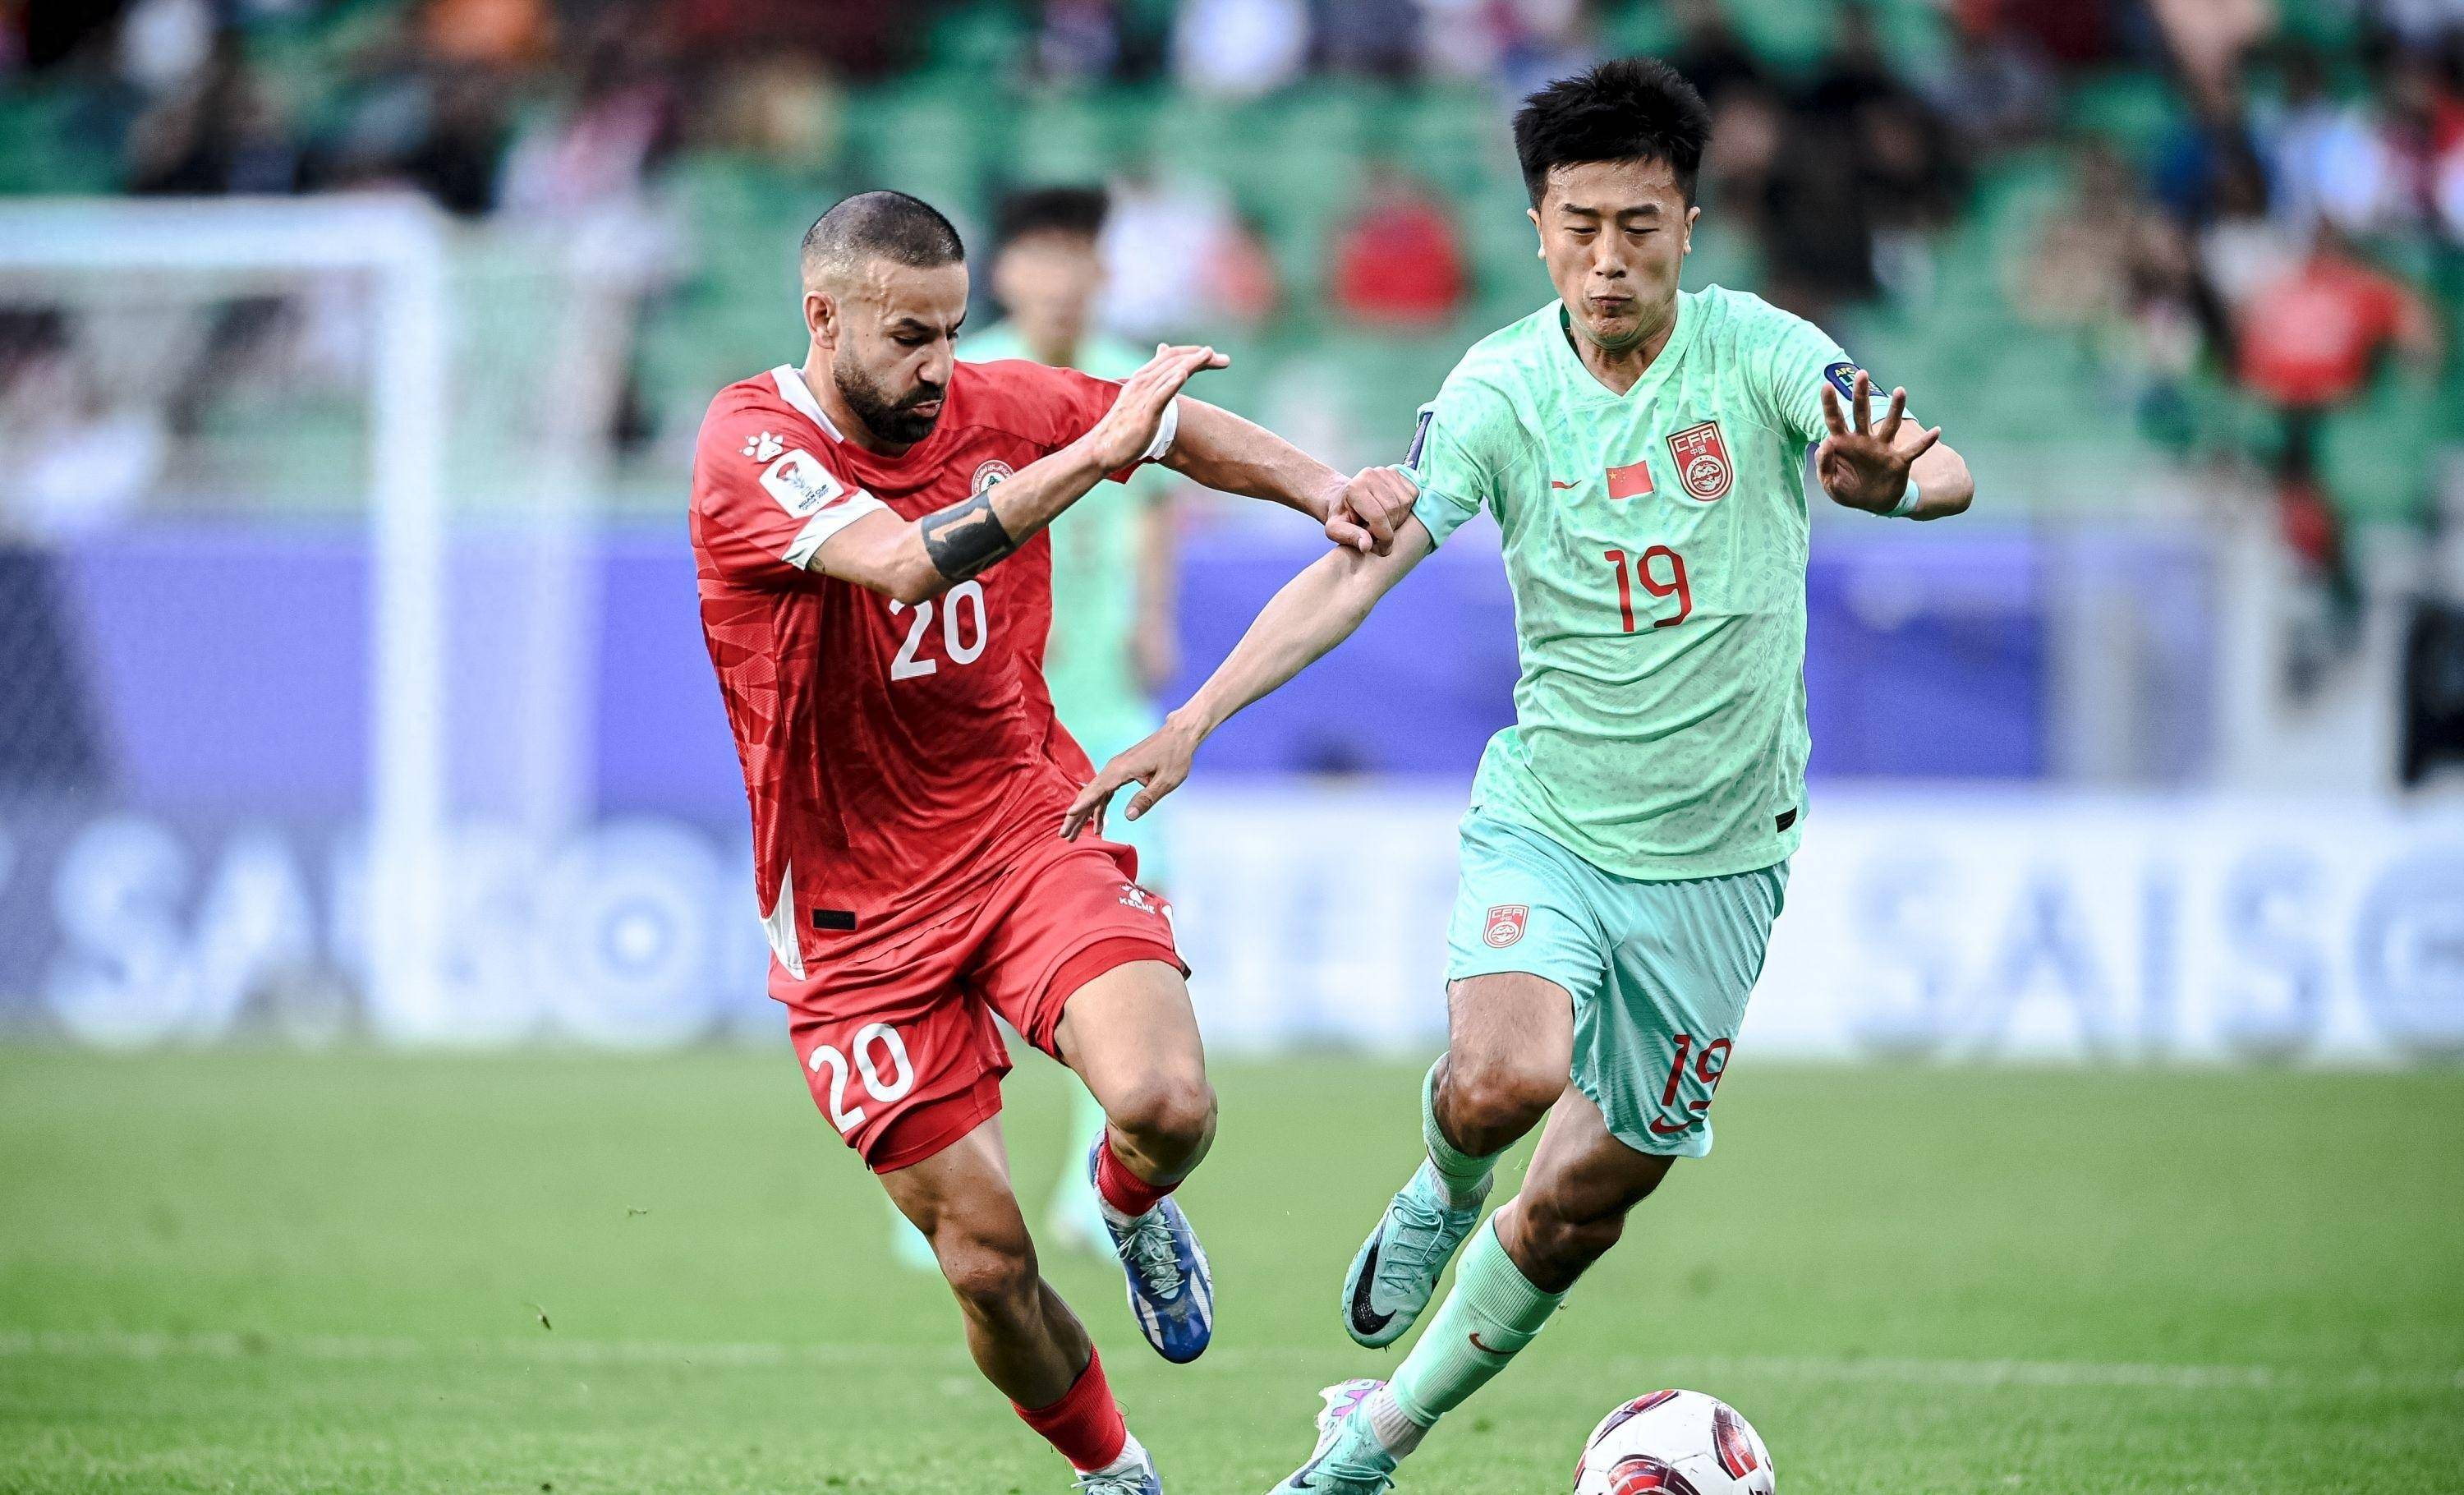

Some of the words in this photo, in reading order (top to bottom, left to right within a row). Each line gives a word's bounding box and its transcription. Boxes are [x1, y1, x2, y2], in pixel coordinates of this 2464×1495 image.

[1834, 367, 1855, 377] AFC
[1674, 428, 1716, 453] CFA
[1603, 545, 1693, 632] 19
[889, 579, 988, 682] 20
[1491, 908, 1525, 919] CFA
[808, 1023, 915, 1134] 20
[1661, 1034, 1732, 1111] 19
